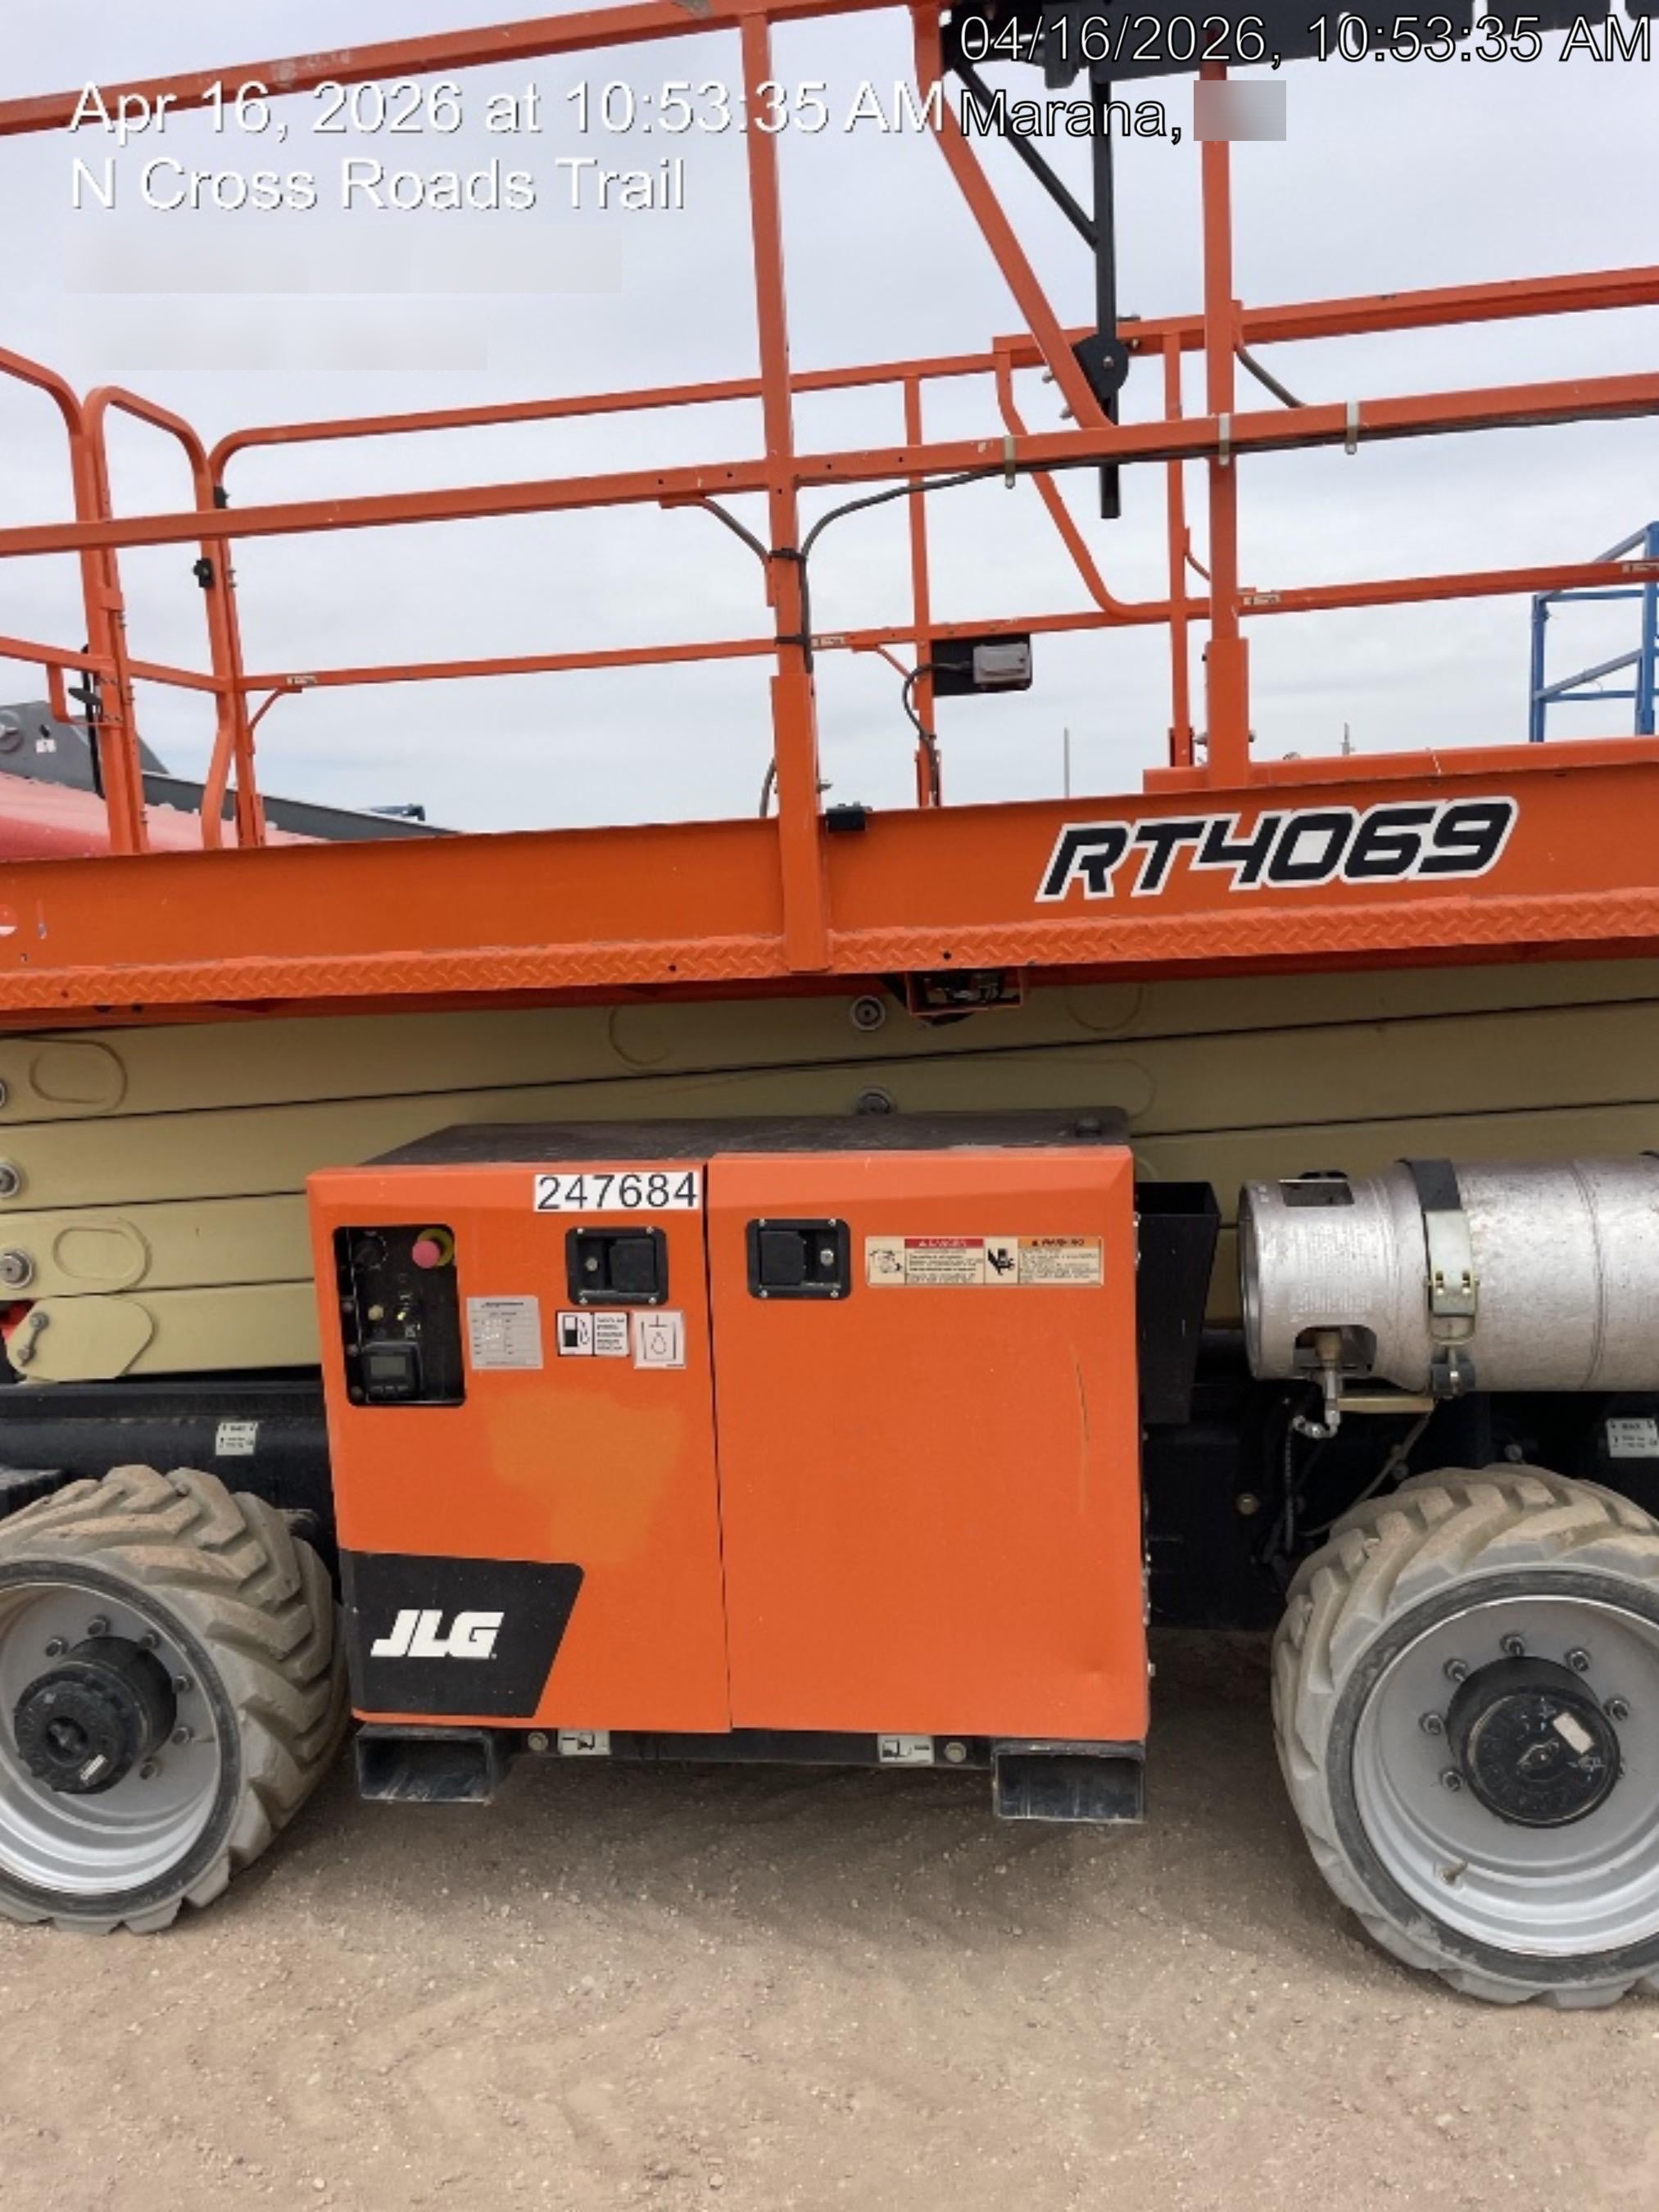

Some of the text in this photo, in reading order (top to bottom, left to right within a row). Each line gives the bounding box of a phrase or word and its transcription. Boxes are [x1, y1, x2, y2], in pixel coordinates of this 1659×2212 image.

[1034, 796, 1517, 903] RT4069
[537, 1173, 698, 1210] 247684
[370, 1609, 505, 1659] JLG
